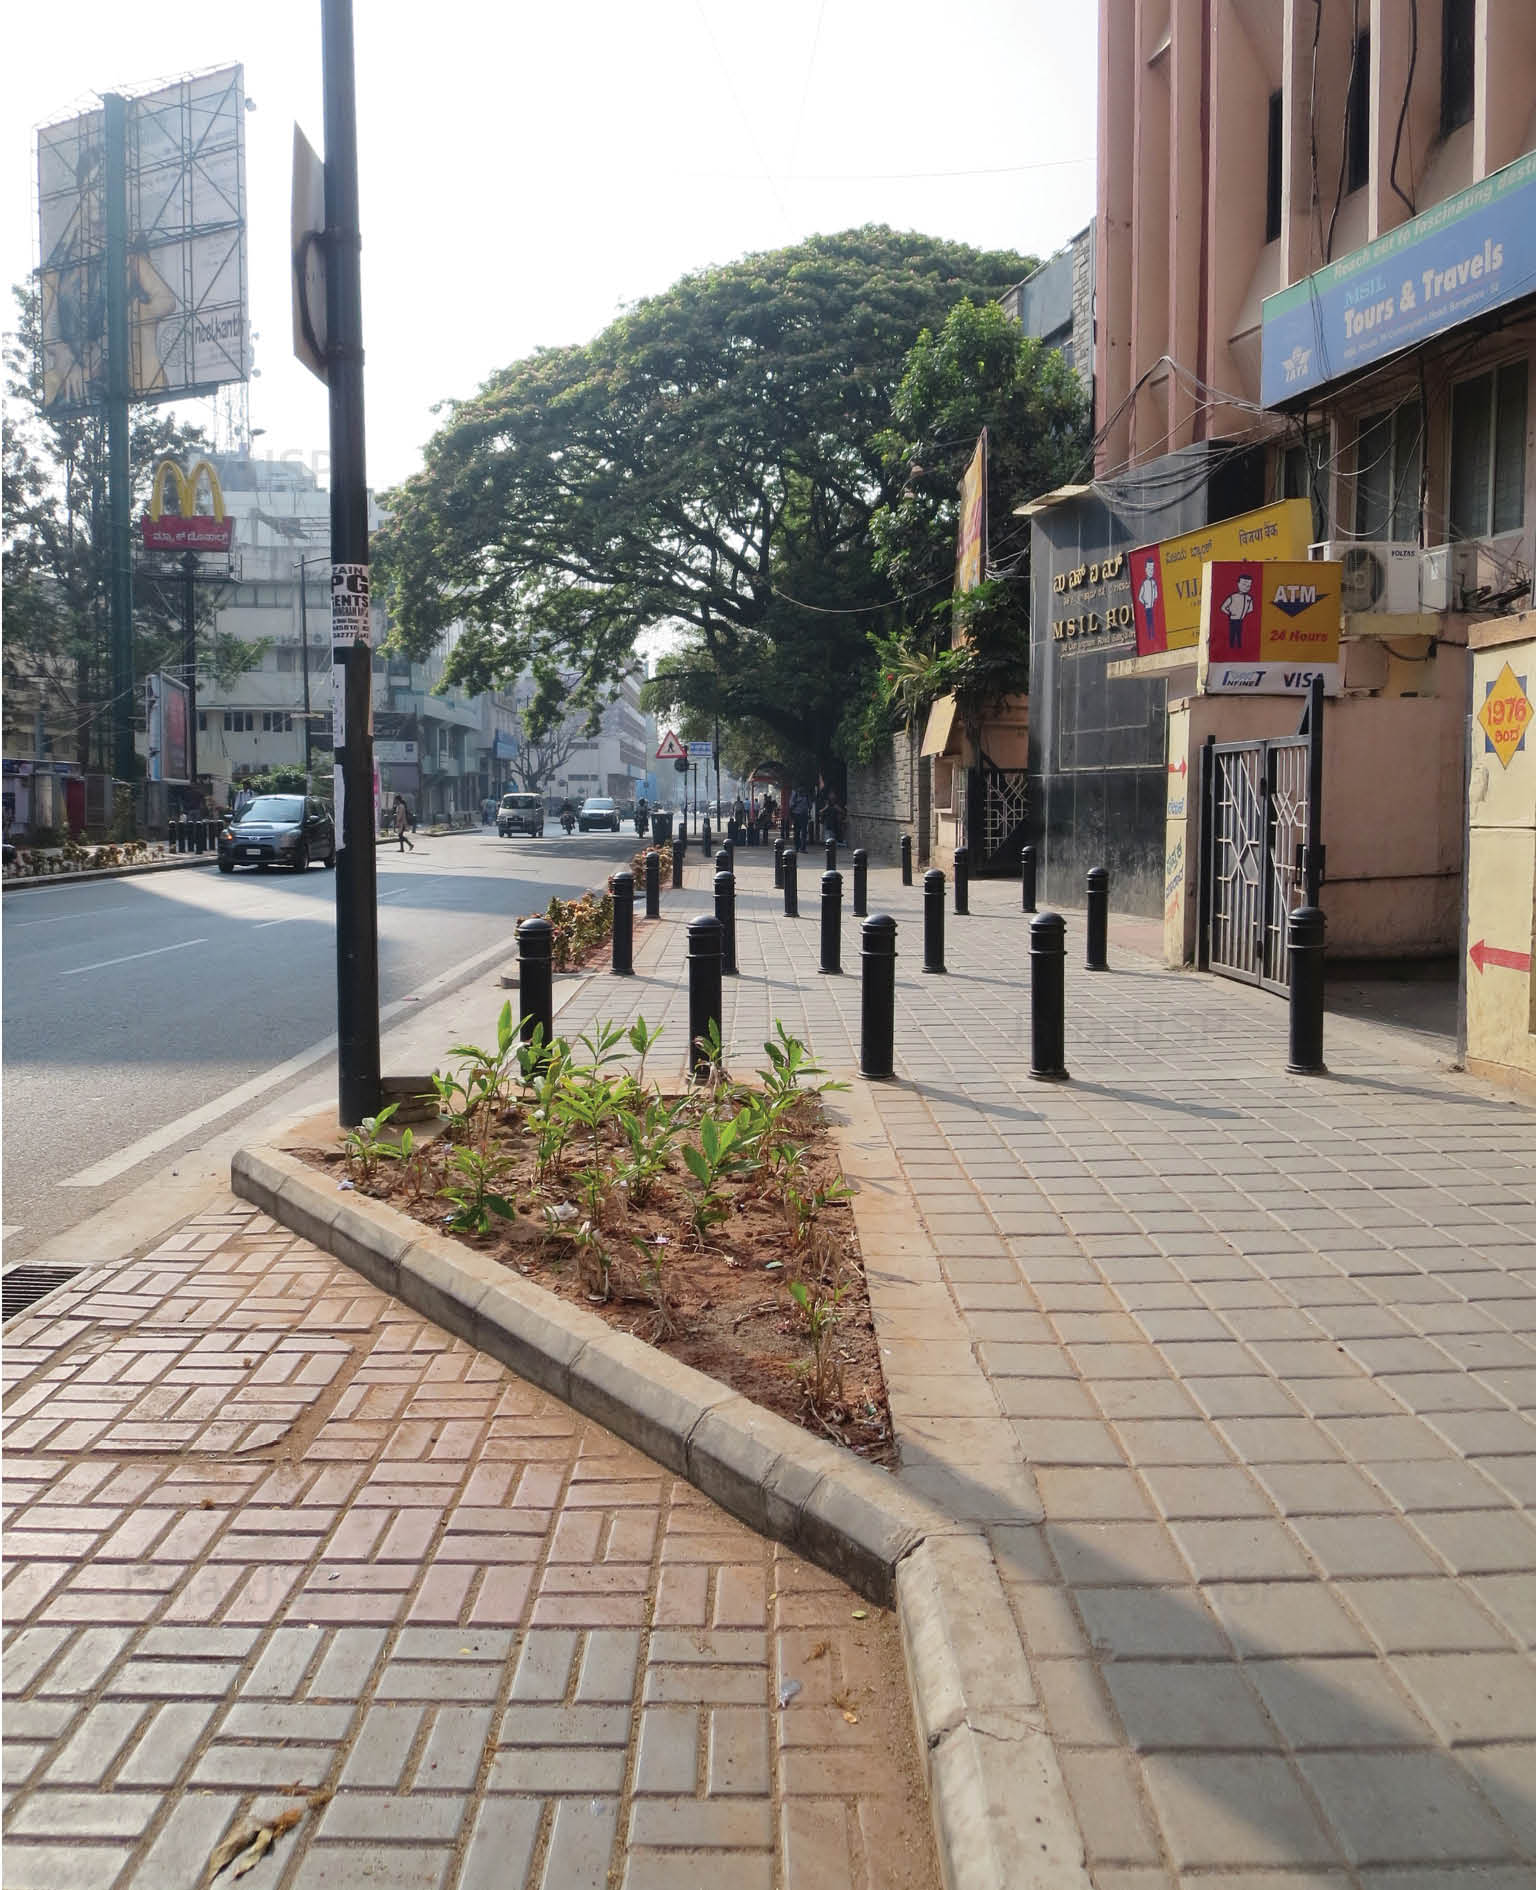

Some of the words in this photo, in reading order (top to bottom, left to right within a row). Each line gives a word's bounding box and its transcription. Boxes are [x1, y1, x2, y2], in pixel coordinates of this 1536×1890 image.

[1344, 296, 1394, 339] Tours
[1400, 280, 1417, 312] &
[1422, 238, 1504, 302] Travels
[331, 574, 369, 594] PG
[1176, 577, 1203, 601] VIJ
[1274, 585, 1317, 603] ATM
[1052, 612, 1098, 641] MSIL
[1270, 628, 1286, 641] 24
[1289, 629, 1328, 643] Hours
[1487, 696, 1527, 726] 1976
